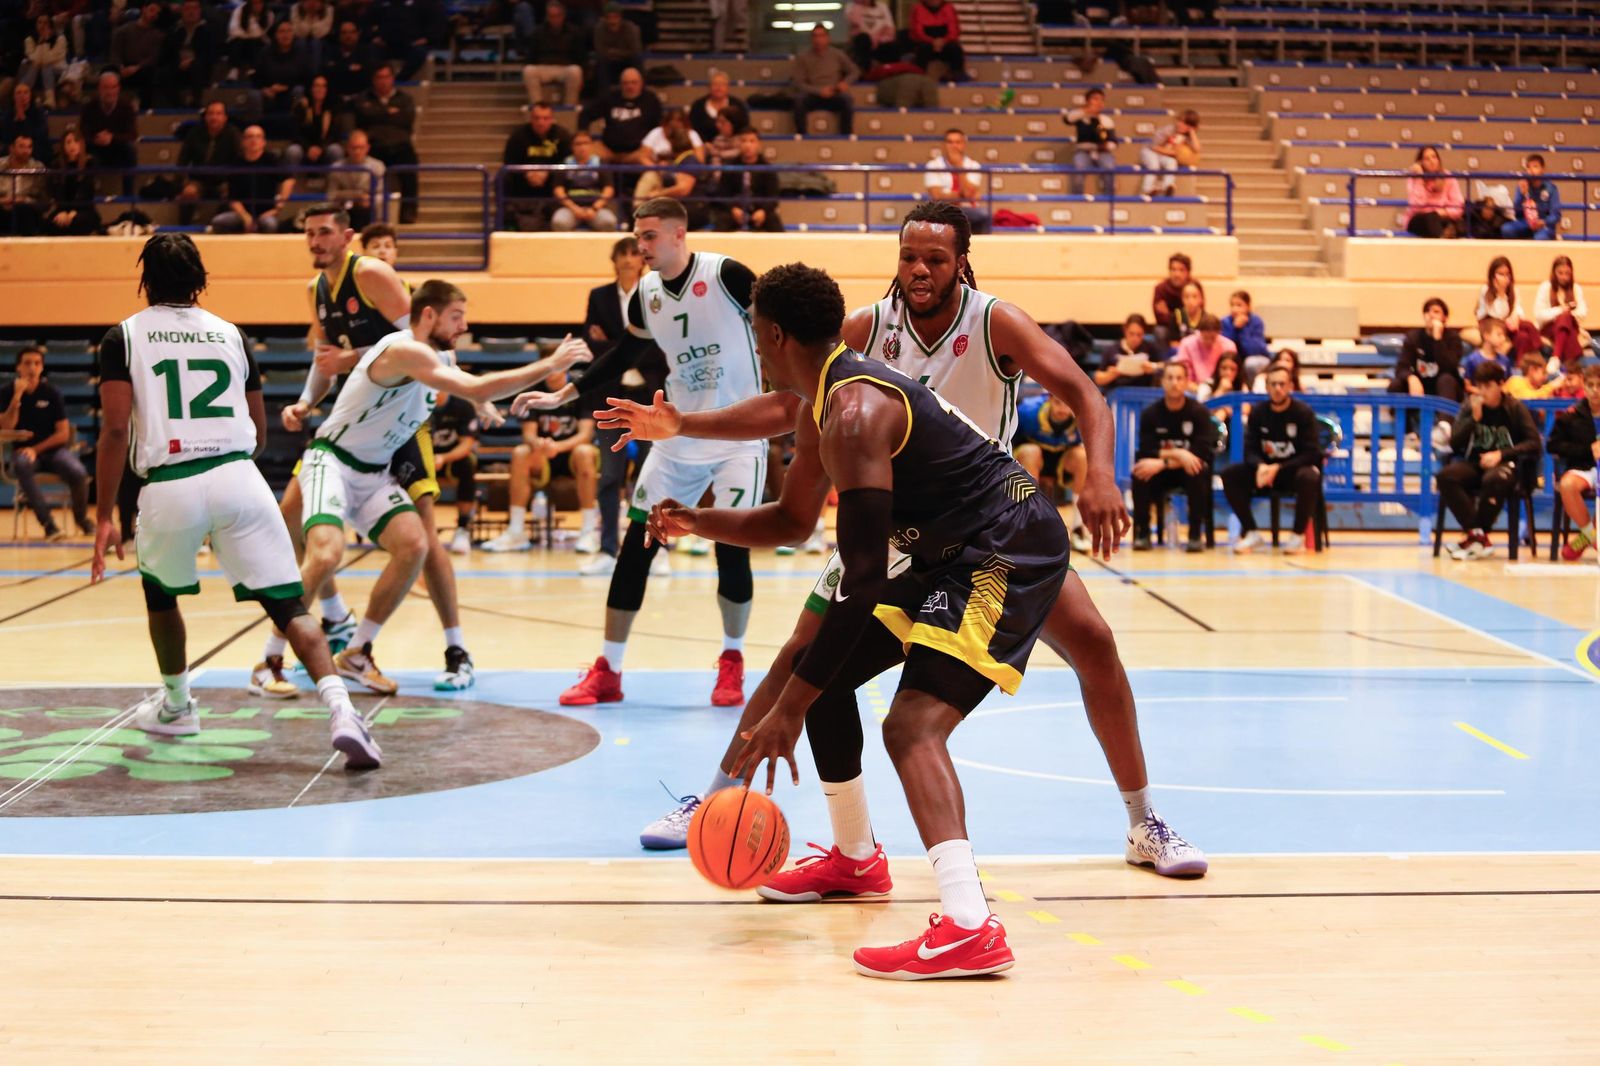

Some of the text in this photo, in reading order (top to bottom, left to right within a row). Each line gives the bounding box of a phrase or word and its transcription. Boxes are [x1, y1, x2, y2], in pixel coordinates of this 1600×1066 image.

[673, 312, 689, 338] 7
[148, 331, 225, 343] KNOWLES
[152, 359, 235, 419] 12
[729, 487, 746, 508] 7
